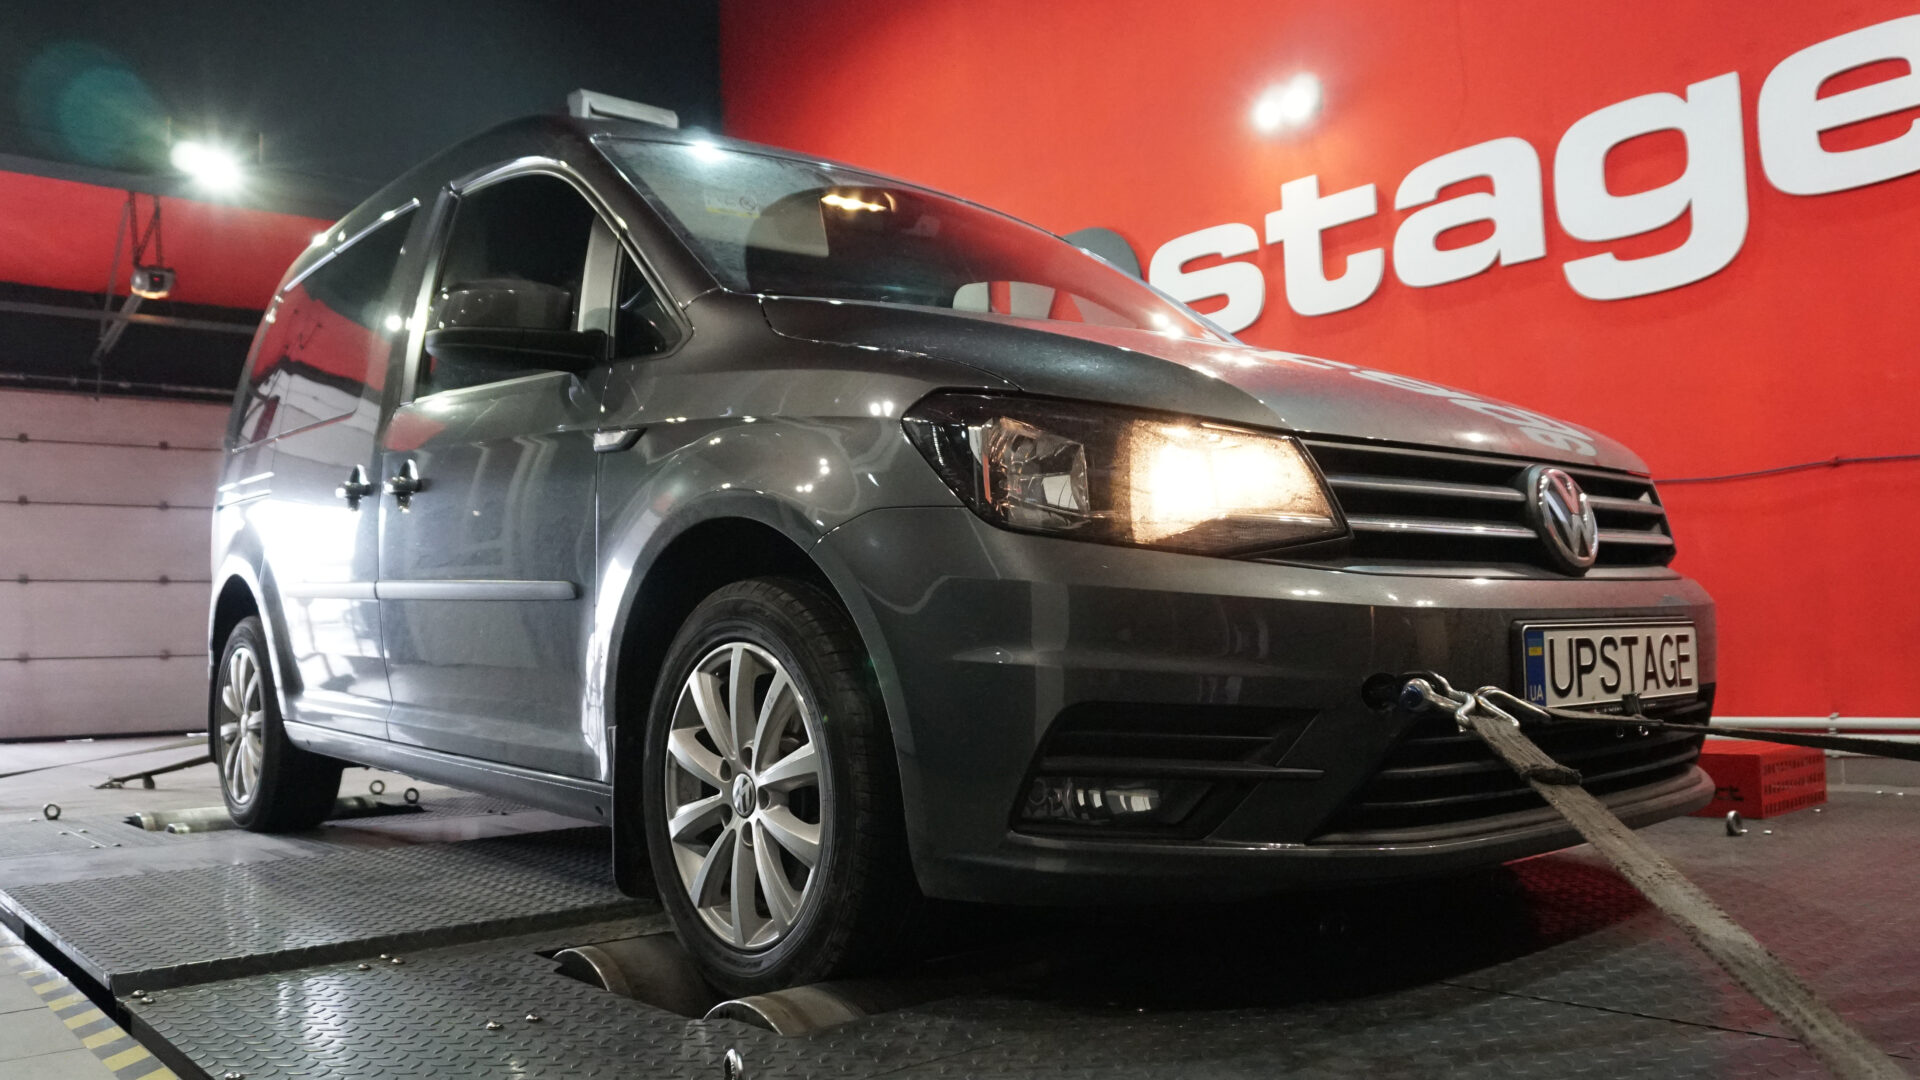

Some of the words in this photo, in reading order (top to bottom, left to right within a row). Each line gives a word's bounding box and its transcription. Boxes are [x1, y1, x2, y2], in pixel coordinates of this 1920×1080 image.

[1062, 14, 1920, 335] stage
[1529, 684, 1544, 702] UA
[1547, 633, 1693, 699] UPSTAGE
